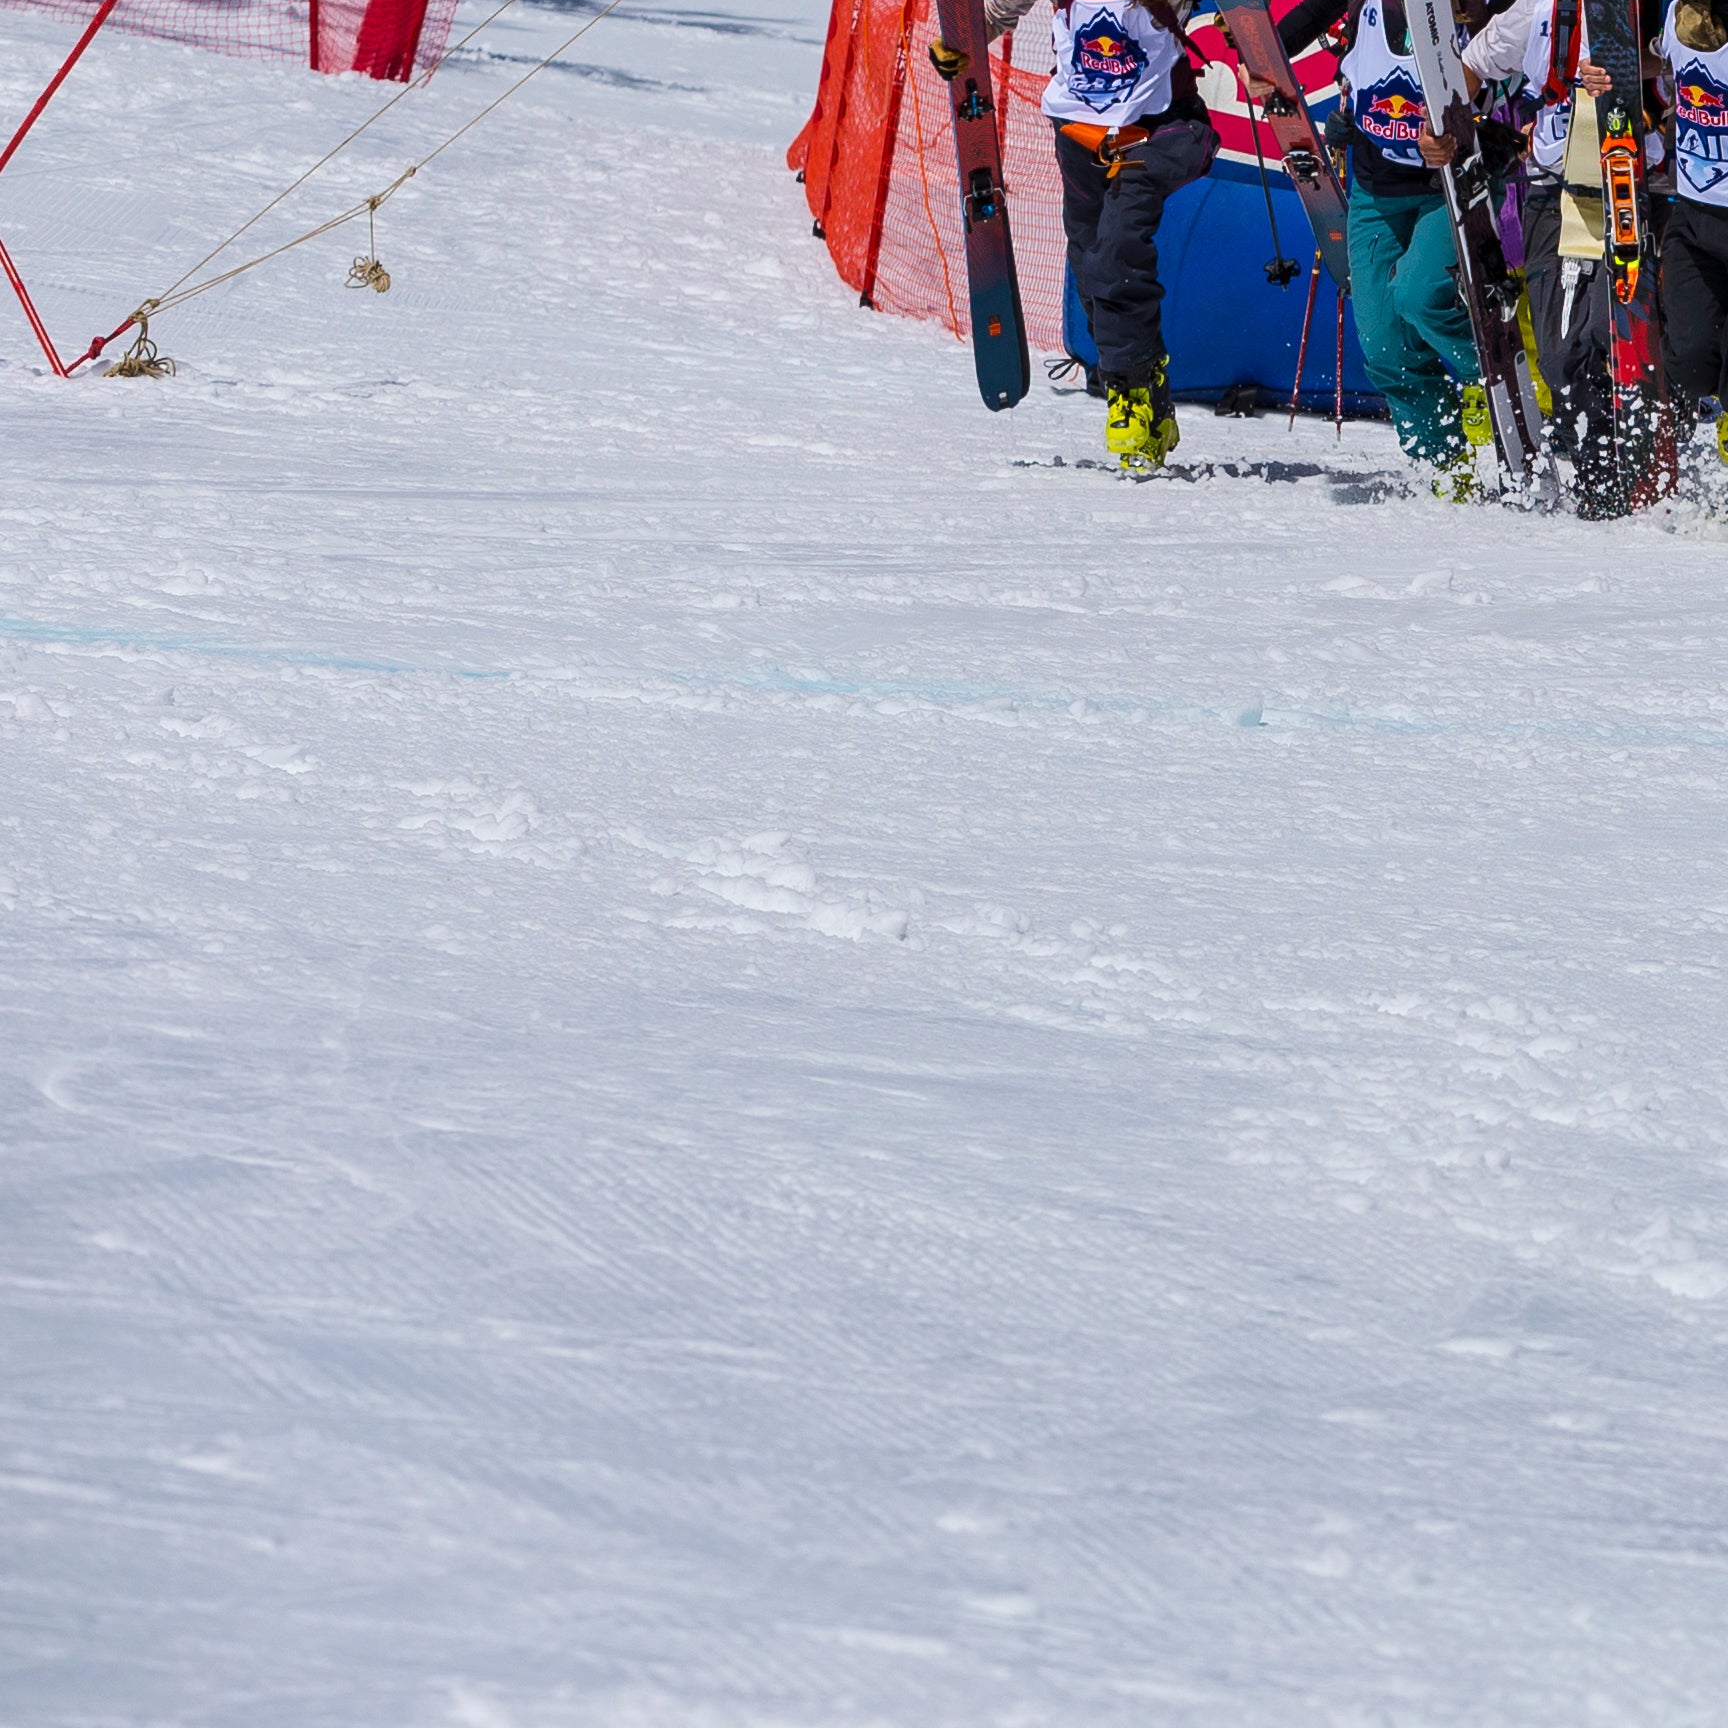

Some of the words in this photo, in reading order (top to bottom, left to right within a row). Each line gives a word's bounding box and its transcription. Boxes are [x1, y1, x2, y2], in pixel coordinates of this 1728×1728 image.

[1425, 1, 1440, 46] ATOMIC
[1081, 52, 1110, 73] Red
[1362, 115, 1395, 141] Red
